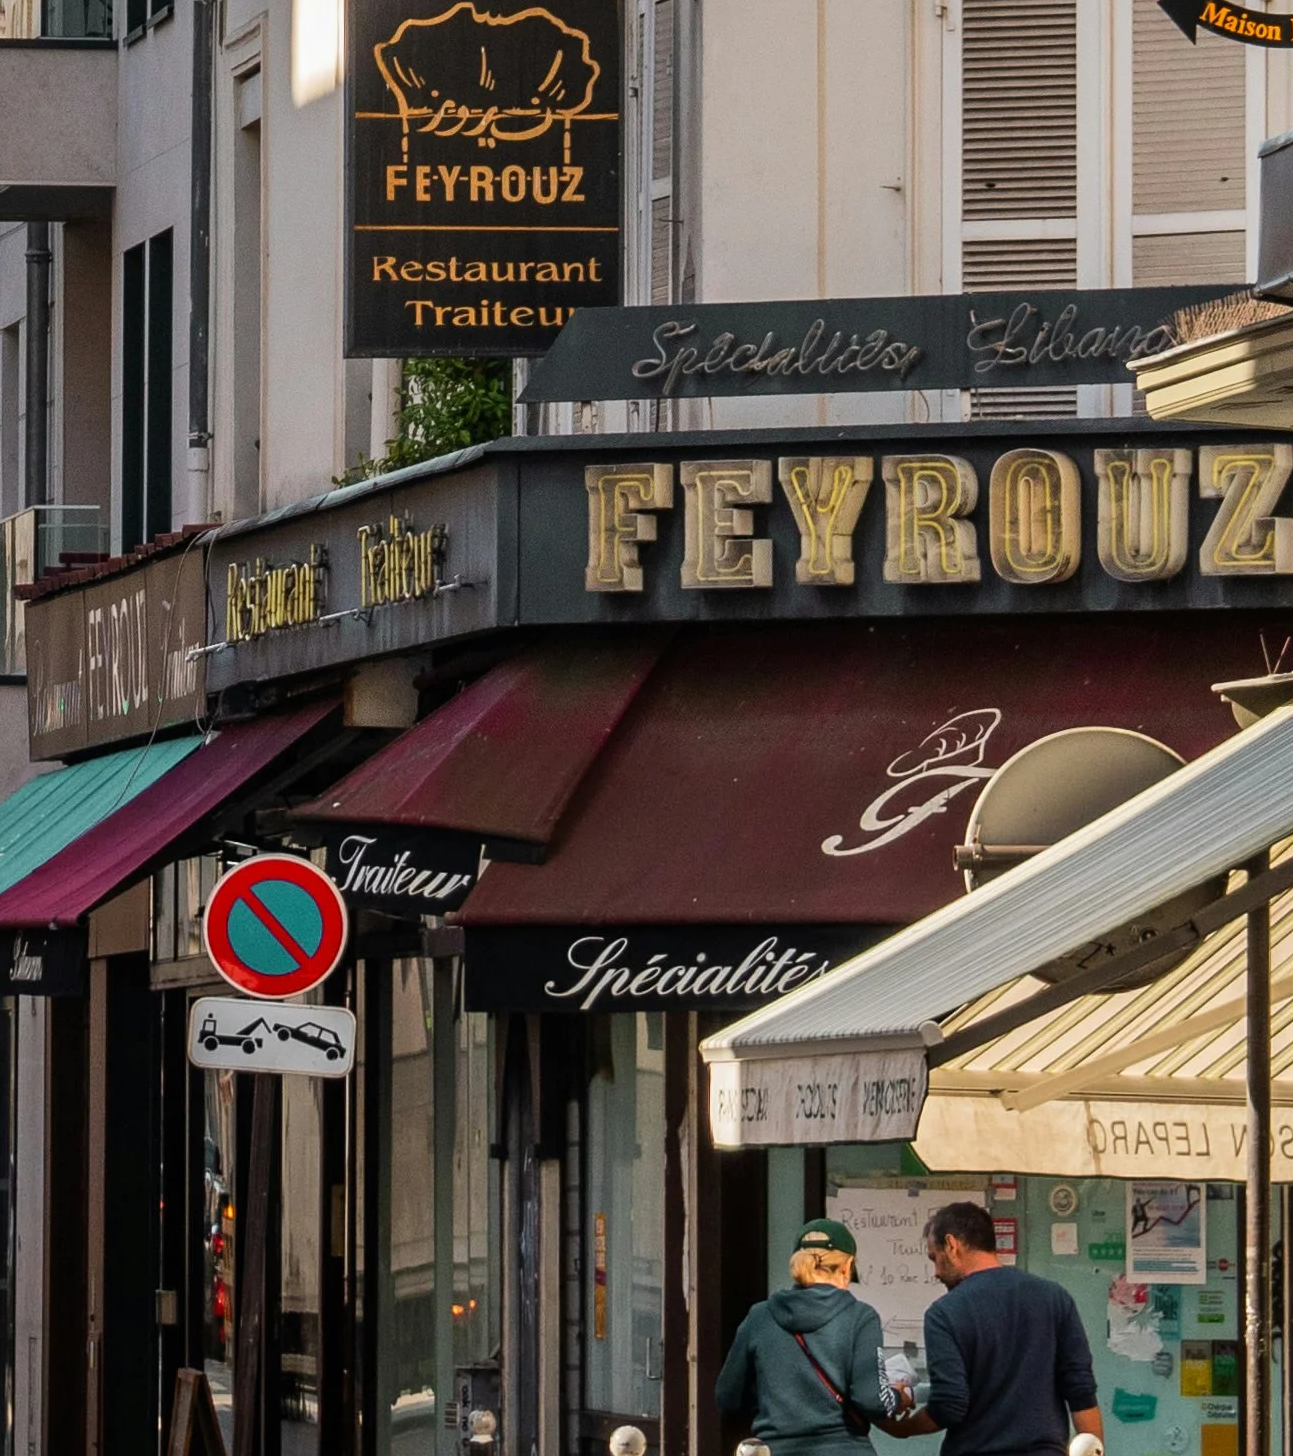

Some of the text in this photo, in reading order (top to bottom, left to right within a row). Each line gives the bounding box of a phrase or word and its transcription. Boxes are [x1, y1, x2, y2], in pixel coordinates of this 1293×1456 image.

[1199, 1, 1283, 43] Maison
[385, 164, 587, 205] FEYROUZ
[372, 254, 604, 284] Restaurant
[338, 834, 473, 900] Traiteur
